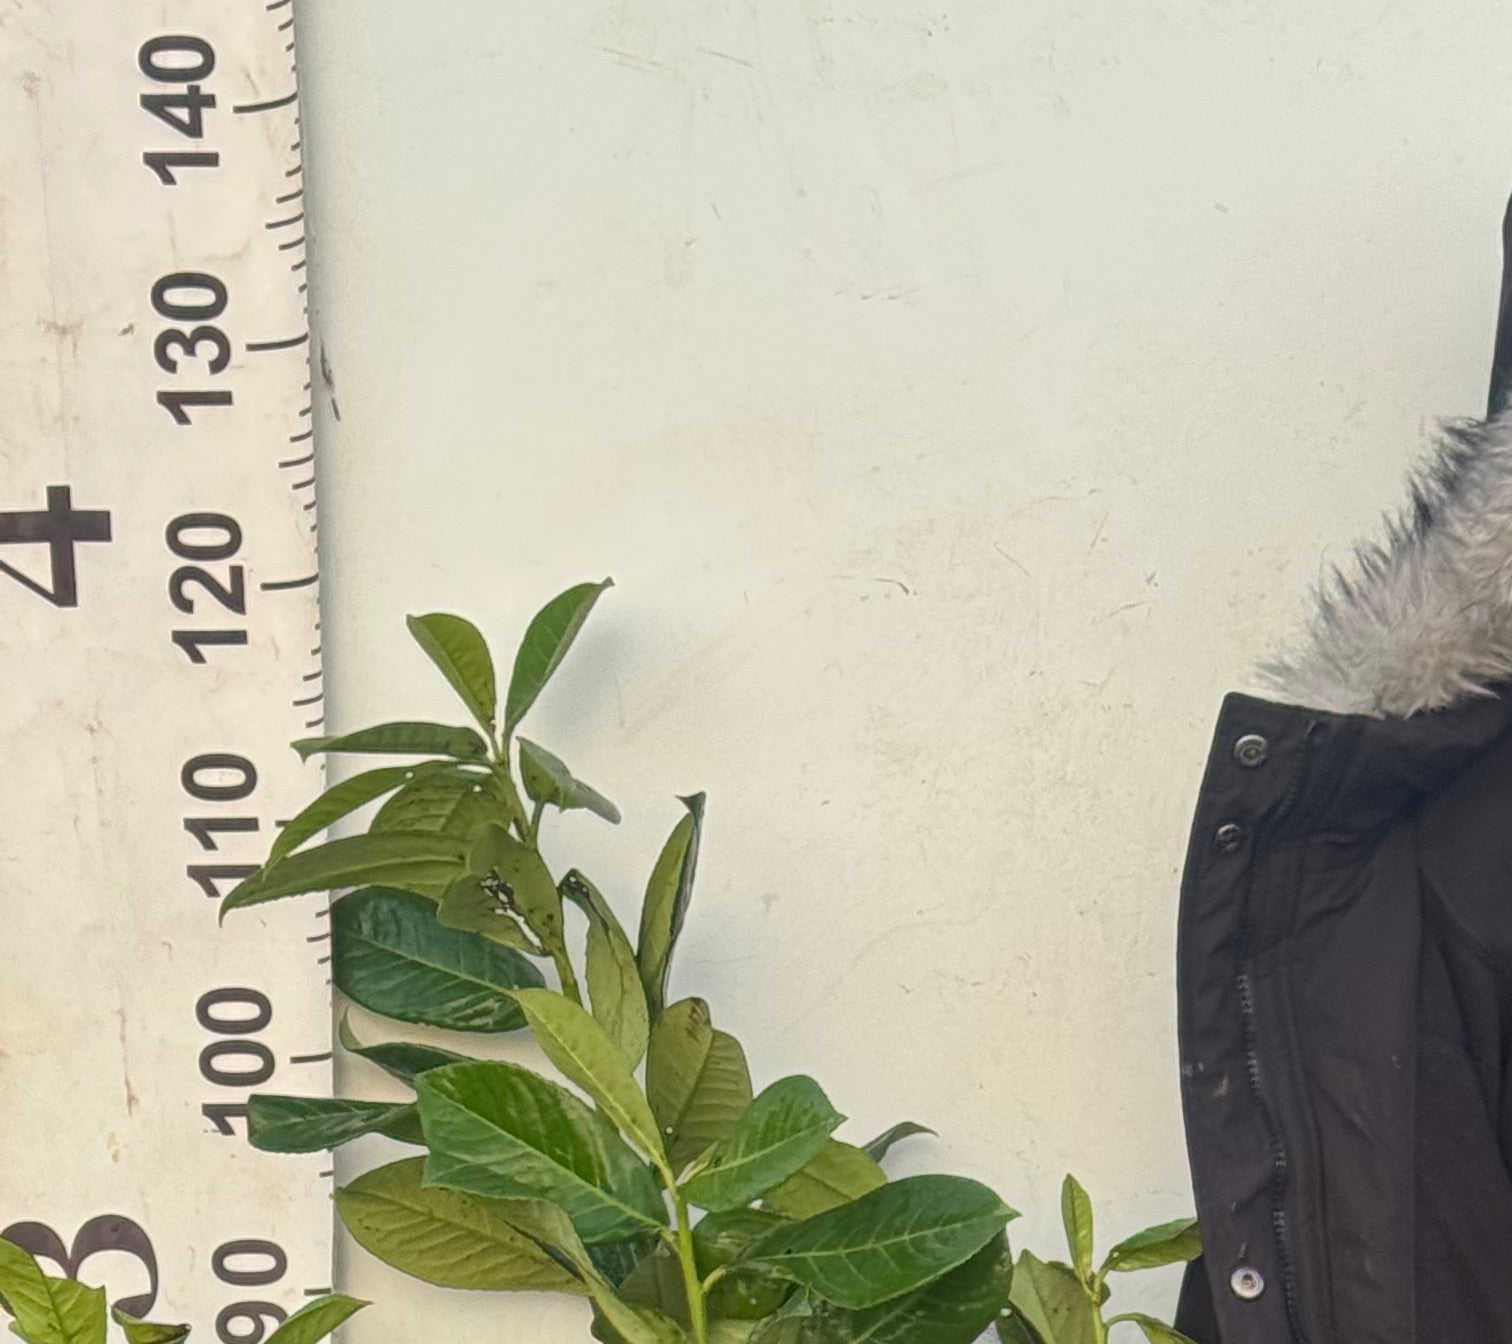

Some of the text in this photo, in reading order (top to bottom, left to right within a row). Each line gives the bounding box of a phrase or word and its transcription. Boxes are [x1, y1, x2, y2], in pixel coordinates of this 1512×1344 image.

[138, 35, 220, 186] 140
[151, 271, 234, 426] 130
[0, 485, 112, 608] 4
[166, 512, 248, 665] 120
[181, 753, 262, 899] 110
[195, 987, 275, 1137] 100
